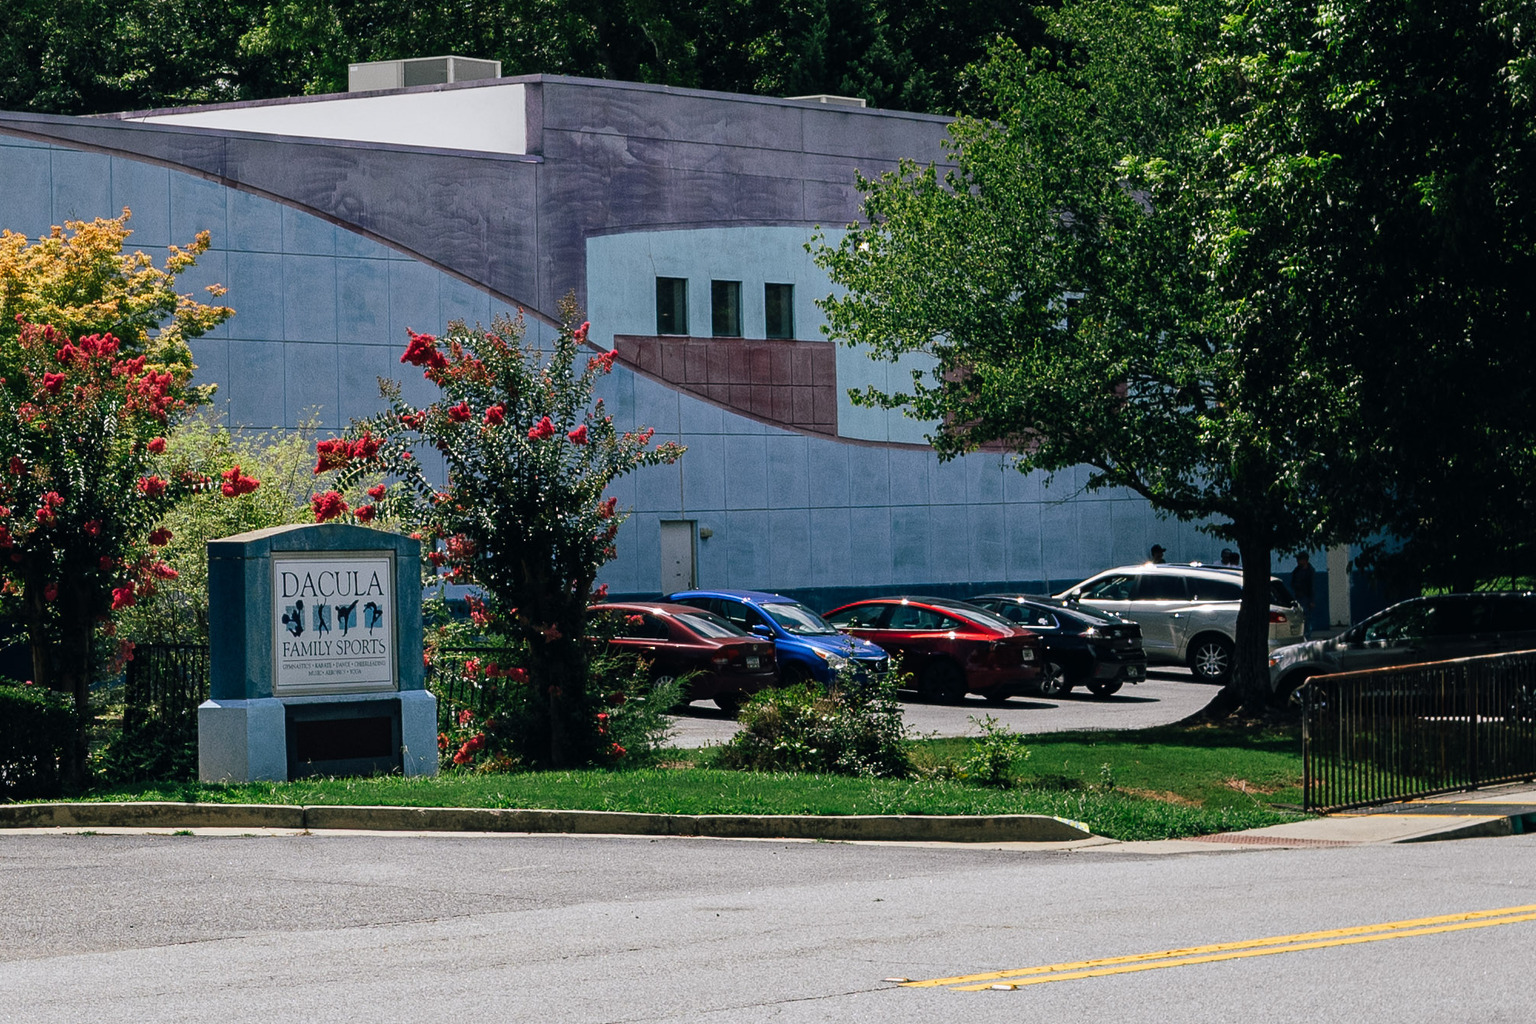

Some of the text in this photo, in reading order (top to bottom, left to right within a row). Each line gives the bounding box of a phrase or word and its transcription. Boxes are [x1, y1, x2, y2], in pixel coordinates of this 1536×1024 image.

[281, 570, 385, 598] DACULA
[282, 638, 386, 657] FAMILY SPORTS
